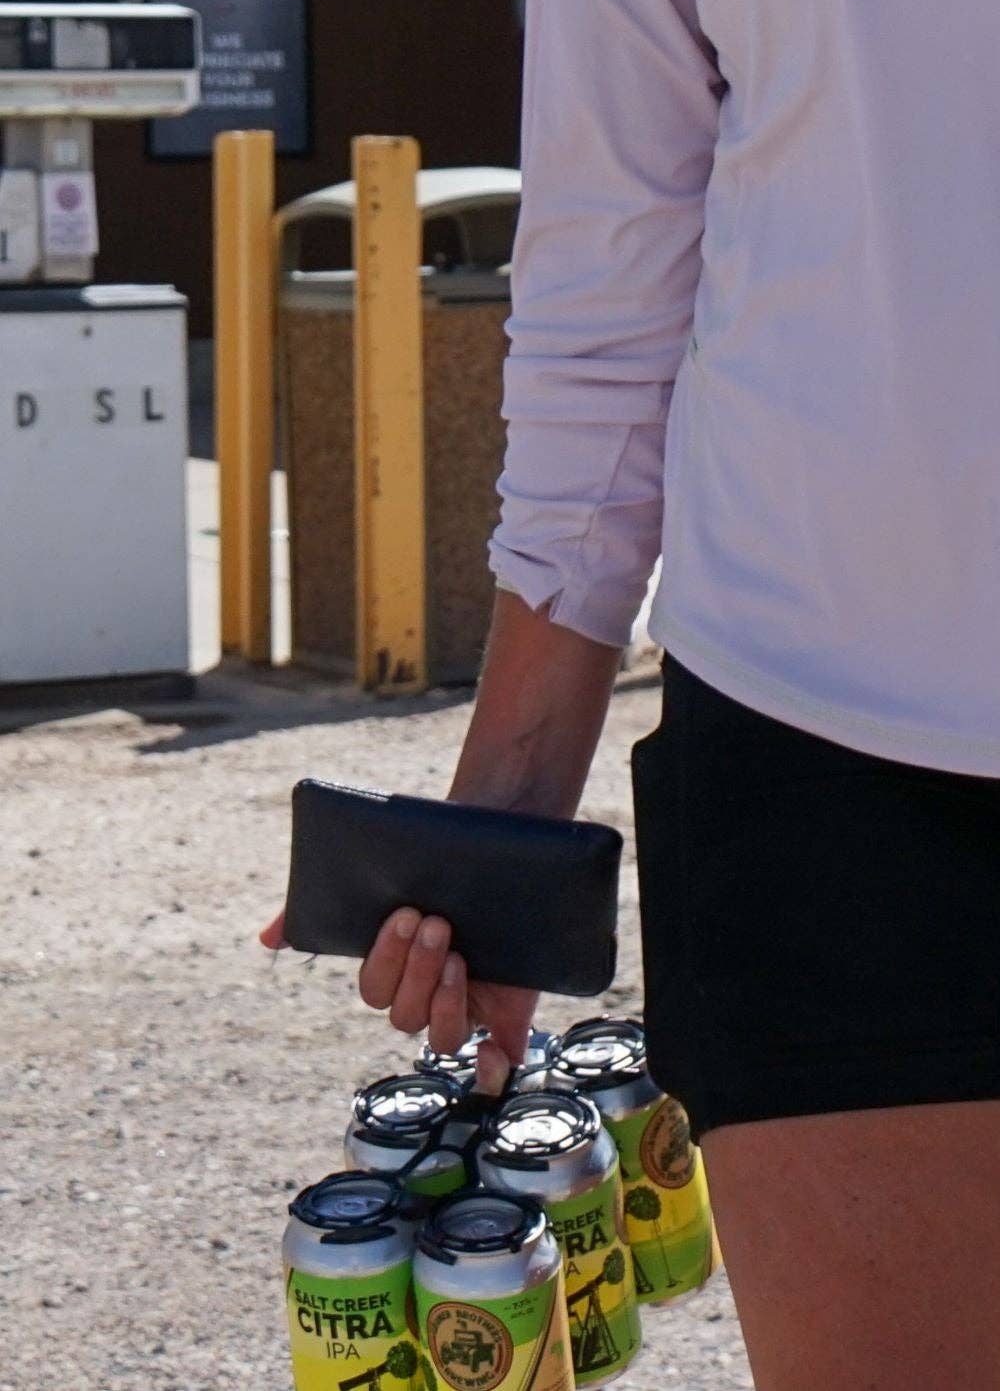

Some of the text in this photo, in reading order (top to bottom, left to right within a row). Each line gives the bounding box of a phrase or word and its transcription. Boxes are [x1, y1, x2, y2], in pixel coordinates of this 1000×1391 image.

[295, 1288, 392, 1312] SALT CREEK
[298, 1306, 396, 1340] CITRA
[326, 1340, 361, 1361] IPA
